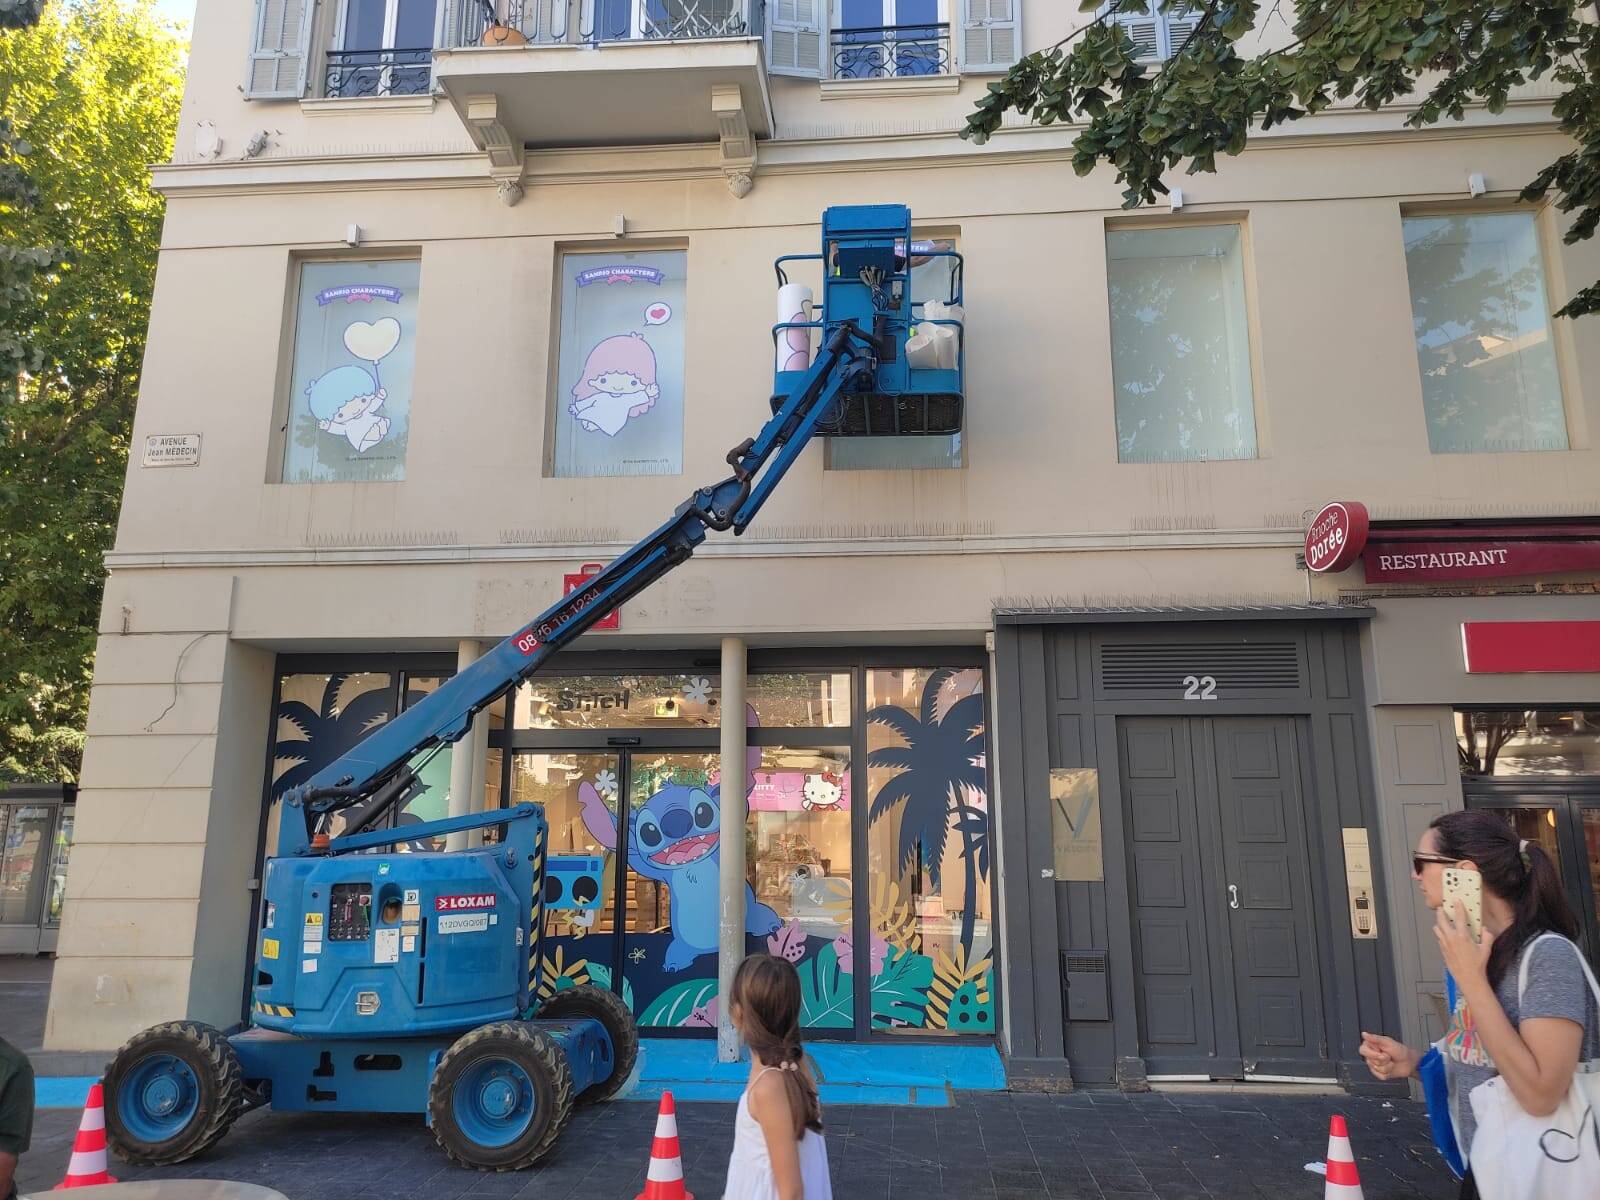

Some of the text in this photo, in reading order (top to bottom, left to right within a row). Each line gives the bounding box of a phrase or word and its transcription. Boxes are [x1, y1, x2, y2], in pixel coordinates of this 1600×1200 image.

[583, 268, 656, 279] SANRIO CHARACTERS
[350, 287, 395, 296] CHARACTERS
[160, 437, 188, 446] AVENUE
[147, 449, 164, 457] Jean
[1311, 511, 1339, 543] Brioche
[1310, 527, 1343, 566] Dorée
[1379, 549, 1508, 571] RESTAURANT
[518, 633, 538, 652] 08
[569, 587, 601, 615] 1234
[1182, 675, 1218, 700] 22
[450, 895, 495, 909] LOXAM
